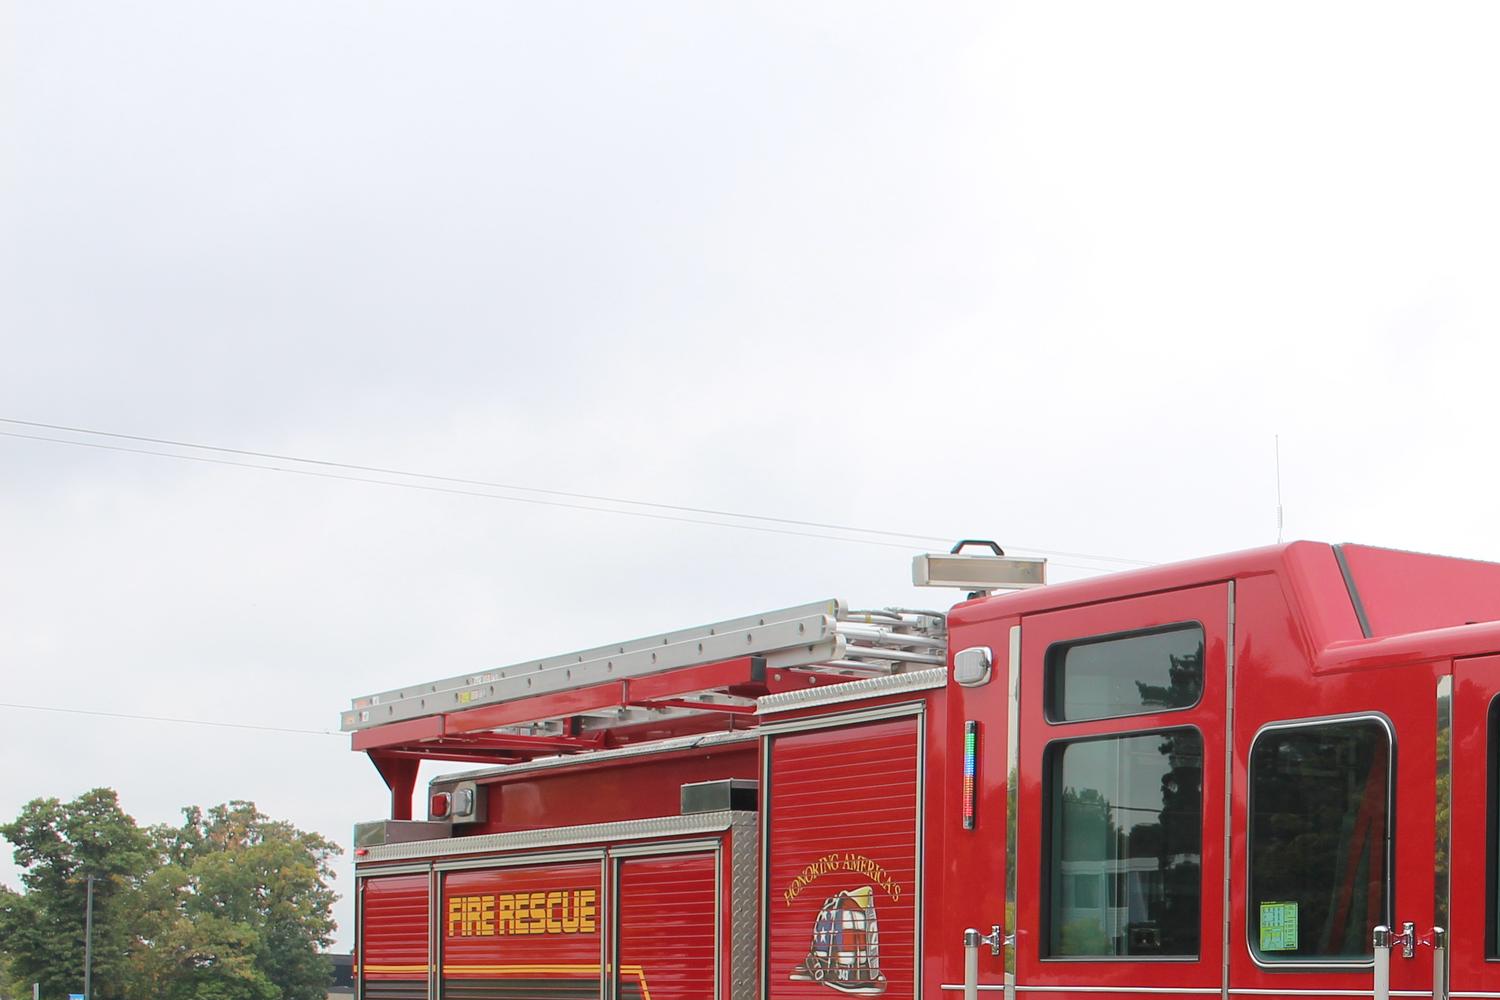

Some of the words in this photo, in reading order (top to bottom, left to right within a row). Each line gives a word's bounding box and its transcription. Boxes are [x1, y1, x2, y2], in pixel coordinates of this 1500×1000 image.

[783, 853, 840, 907] HONORING
[842, 853, 901, 902] AMERICA'S
[448, 895, 496, 937] FIRE
[498, 889, 597, 936] RESCUE
